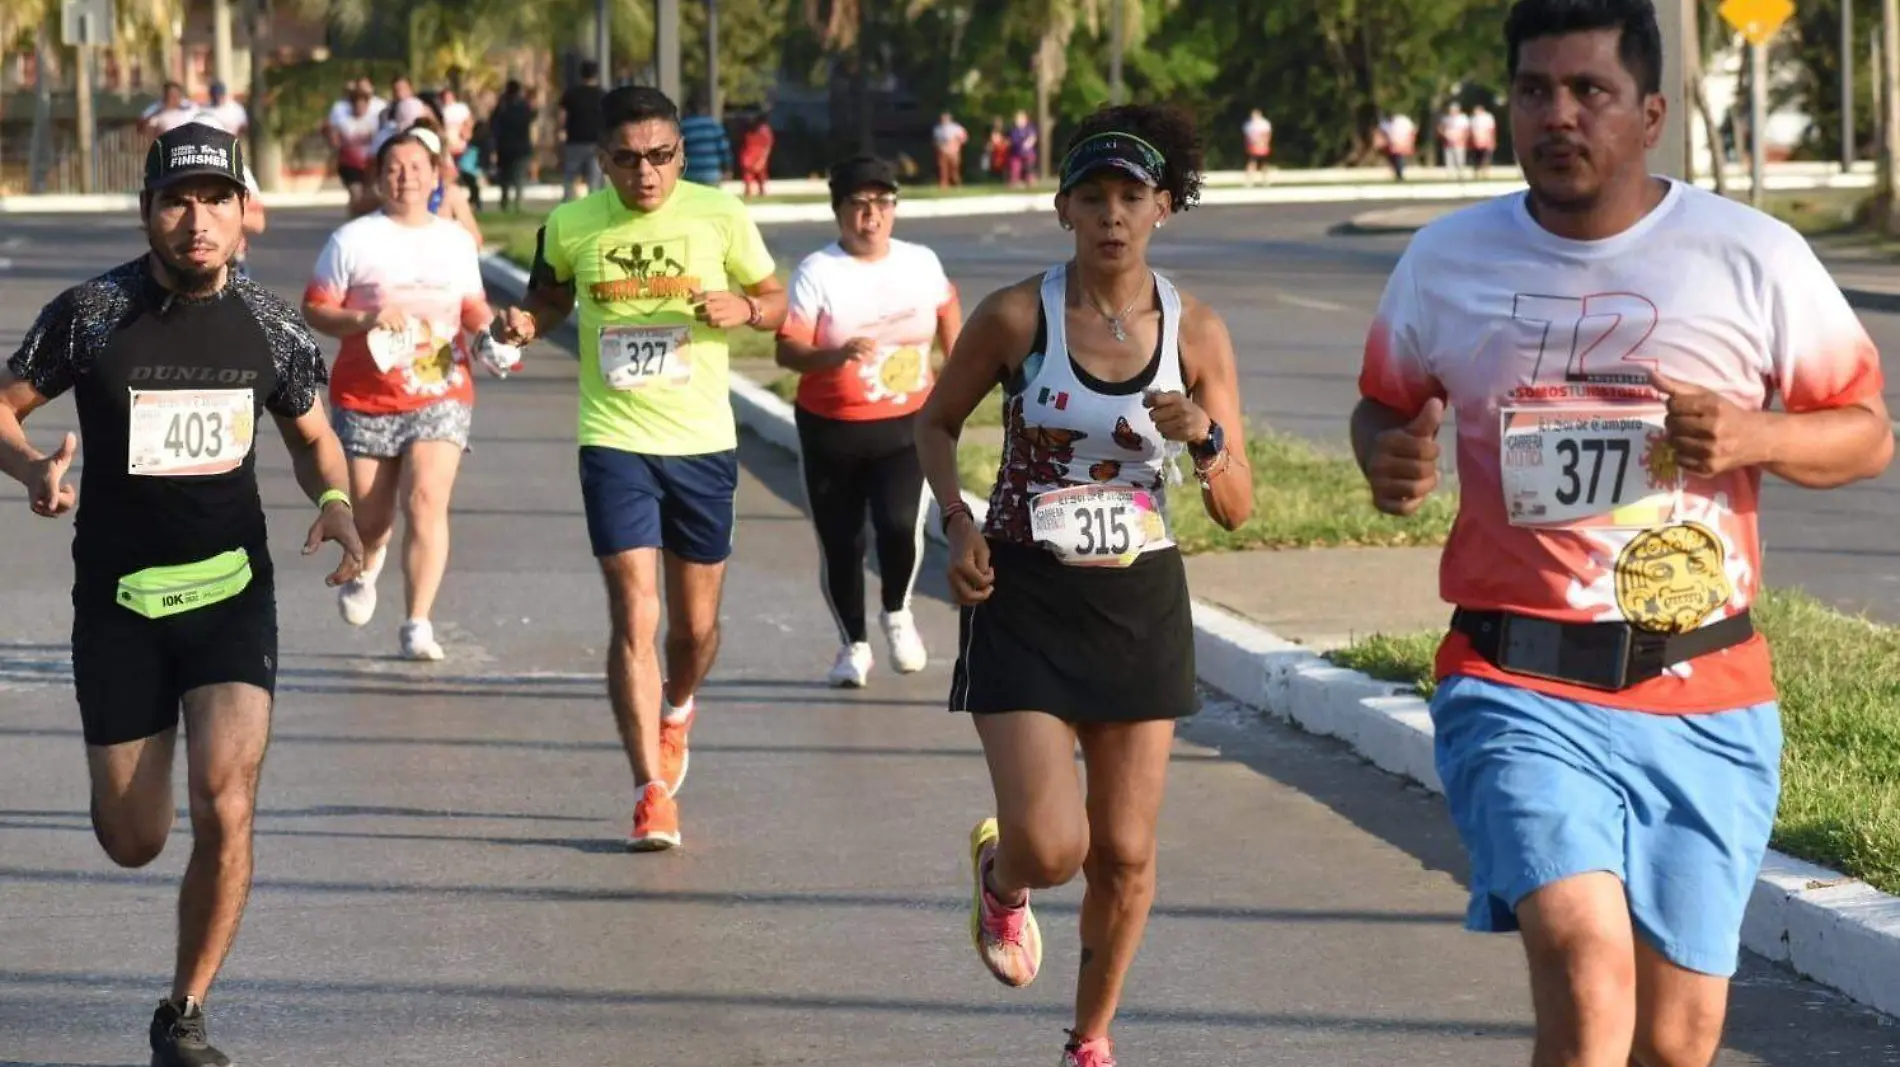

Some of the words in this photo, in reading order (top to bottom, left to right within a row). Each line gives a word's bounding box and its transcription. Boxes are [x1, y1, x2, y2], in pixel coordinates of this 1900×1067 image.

[170, 155, 228, 168] FINISHER
[1511, 291, 1658, 384] 72
[130, 365, 258, 384] DUNLOP
[627, 341, 667, 376] 327
[164, 411, 222, 458] 403
[1555, 438, 1630, 505] 377
[1075, 506, 1129, 555] 315
[162, 594, 184, 607] 10K
